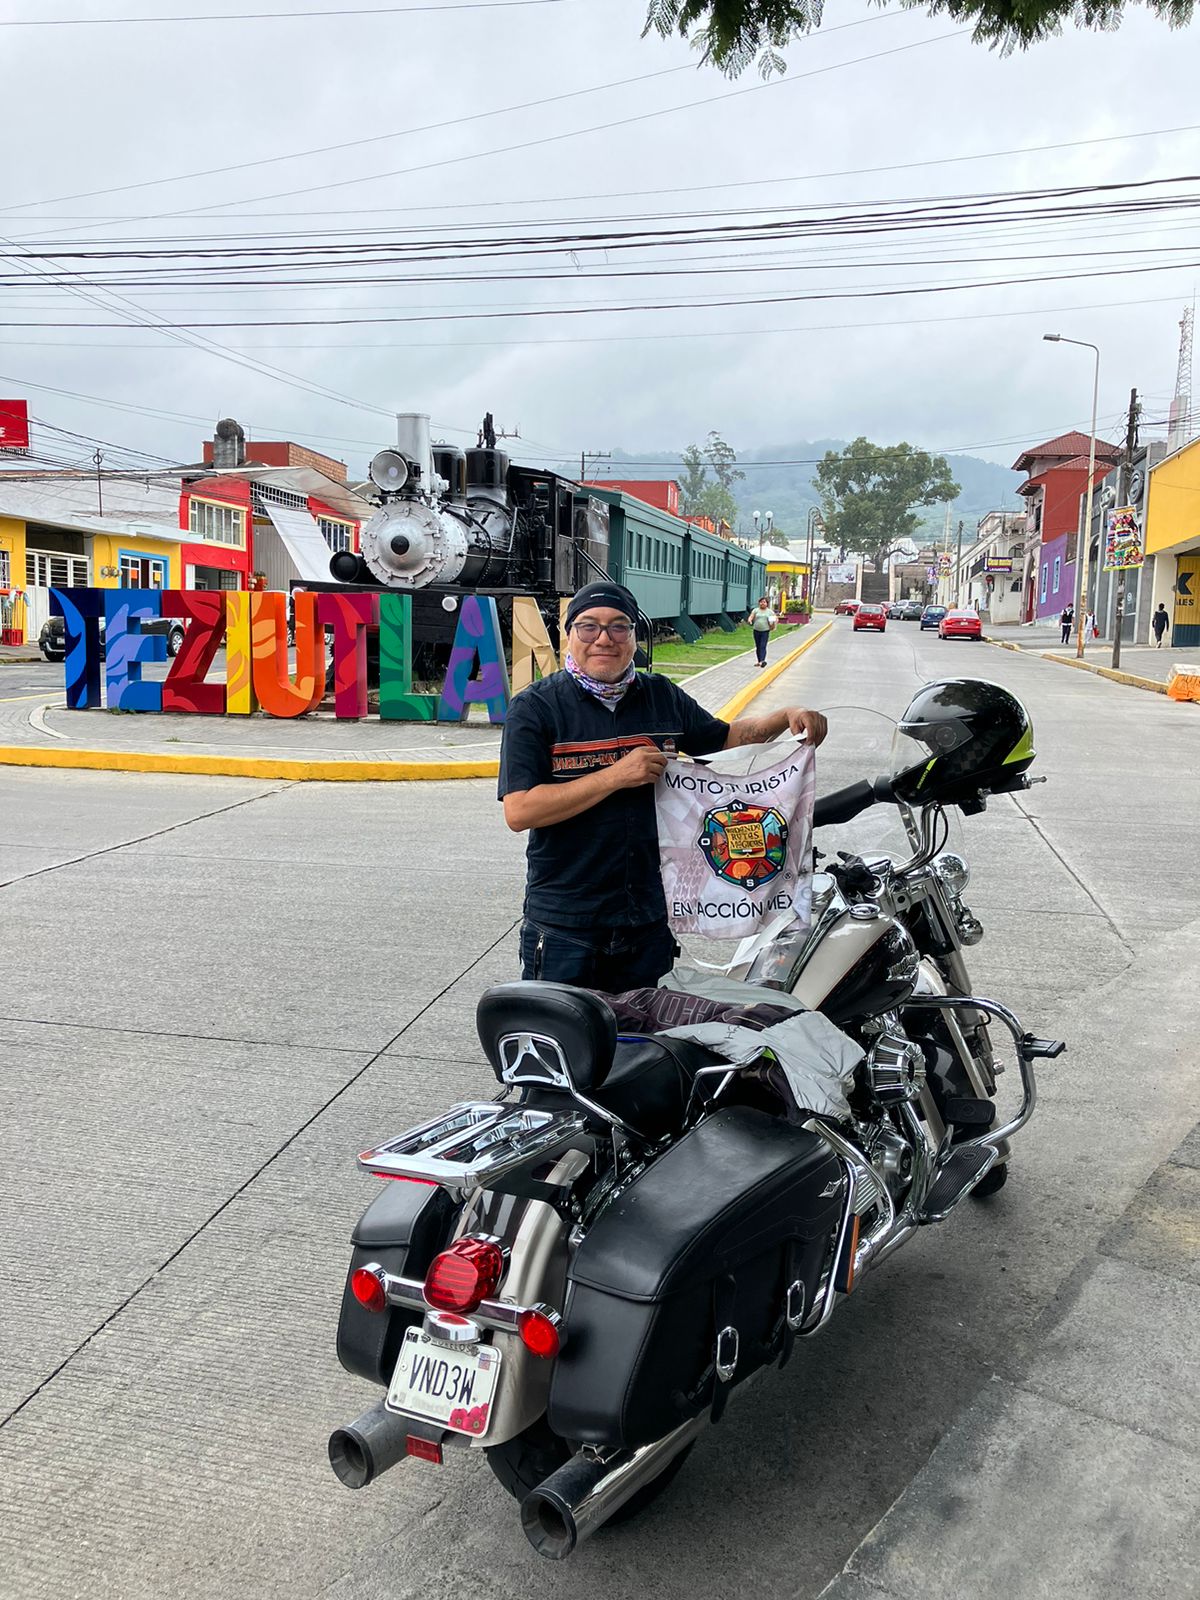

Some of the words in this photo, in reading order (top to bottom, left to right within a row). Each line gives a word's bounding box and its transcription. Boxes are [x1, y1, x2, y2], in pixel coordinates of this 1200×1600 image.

[664, 771, 724, 795] MOTO
[732, 803, 743, 811] N
[746, 878, 755, 887] S
[673, 901, 693, 917] EN
[697, 897, 764, 919] ACCIÓN
[408, 1353, 477, 1406] VND3W
